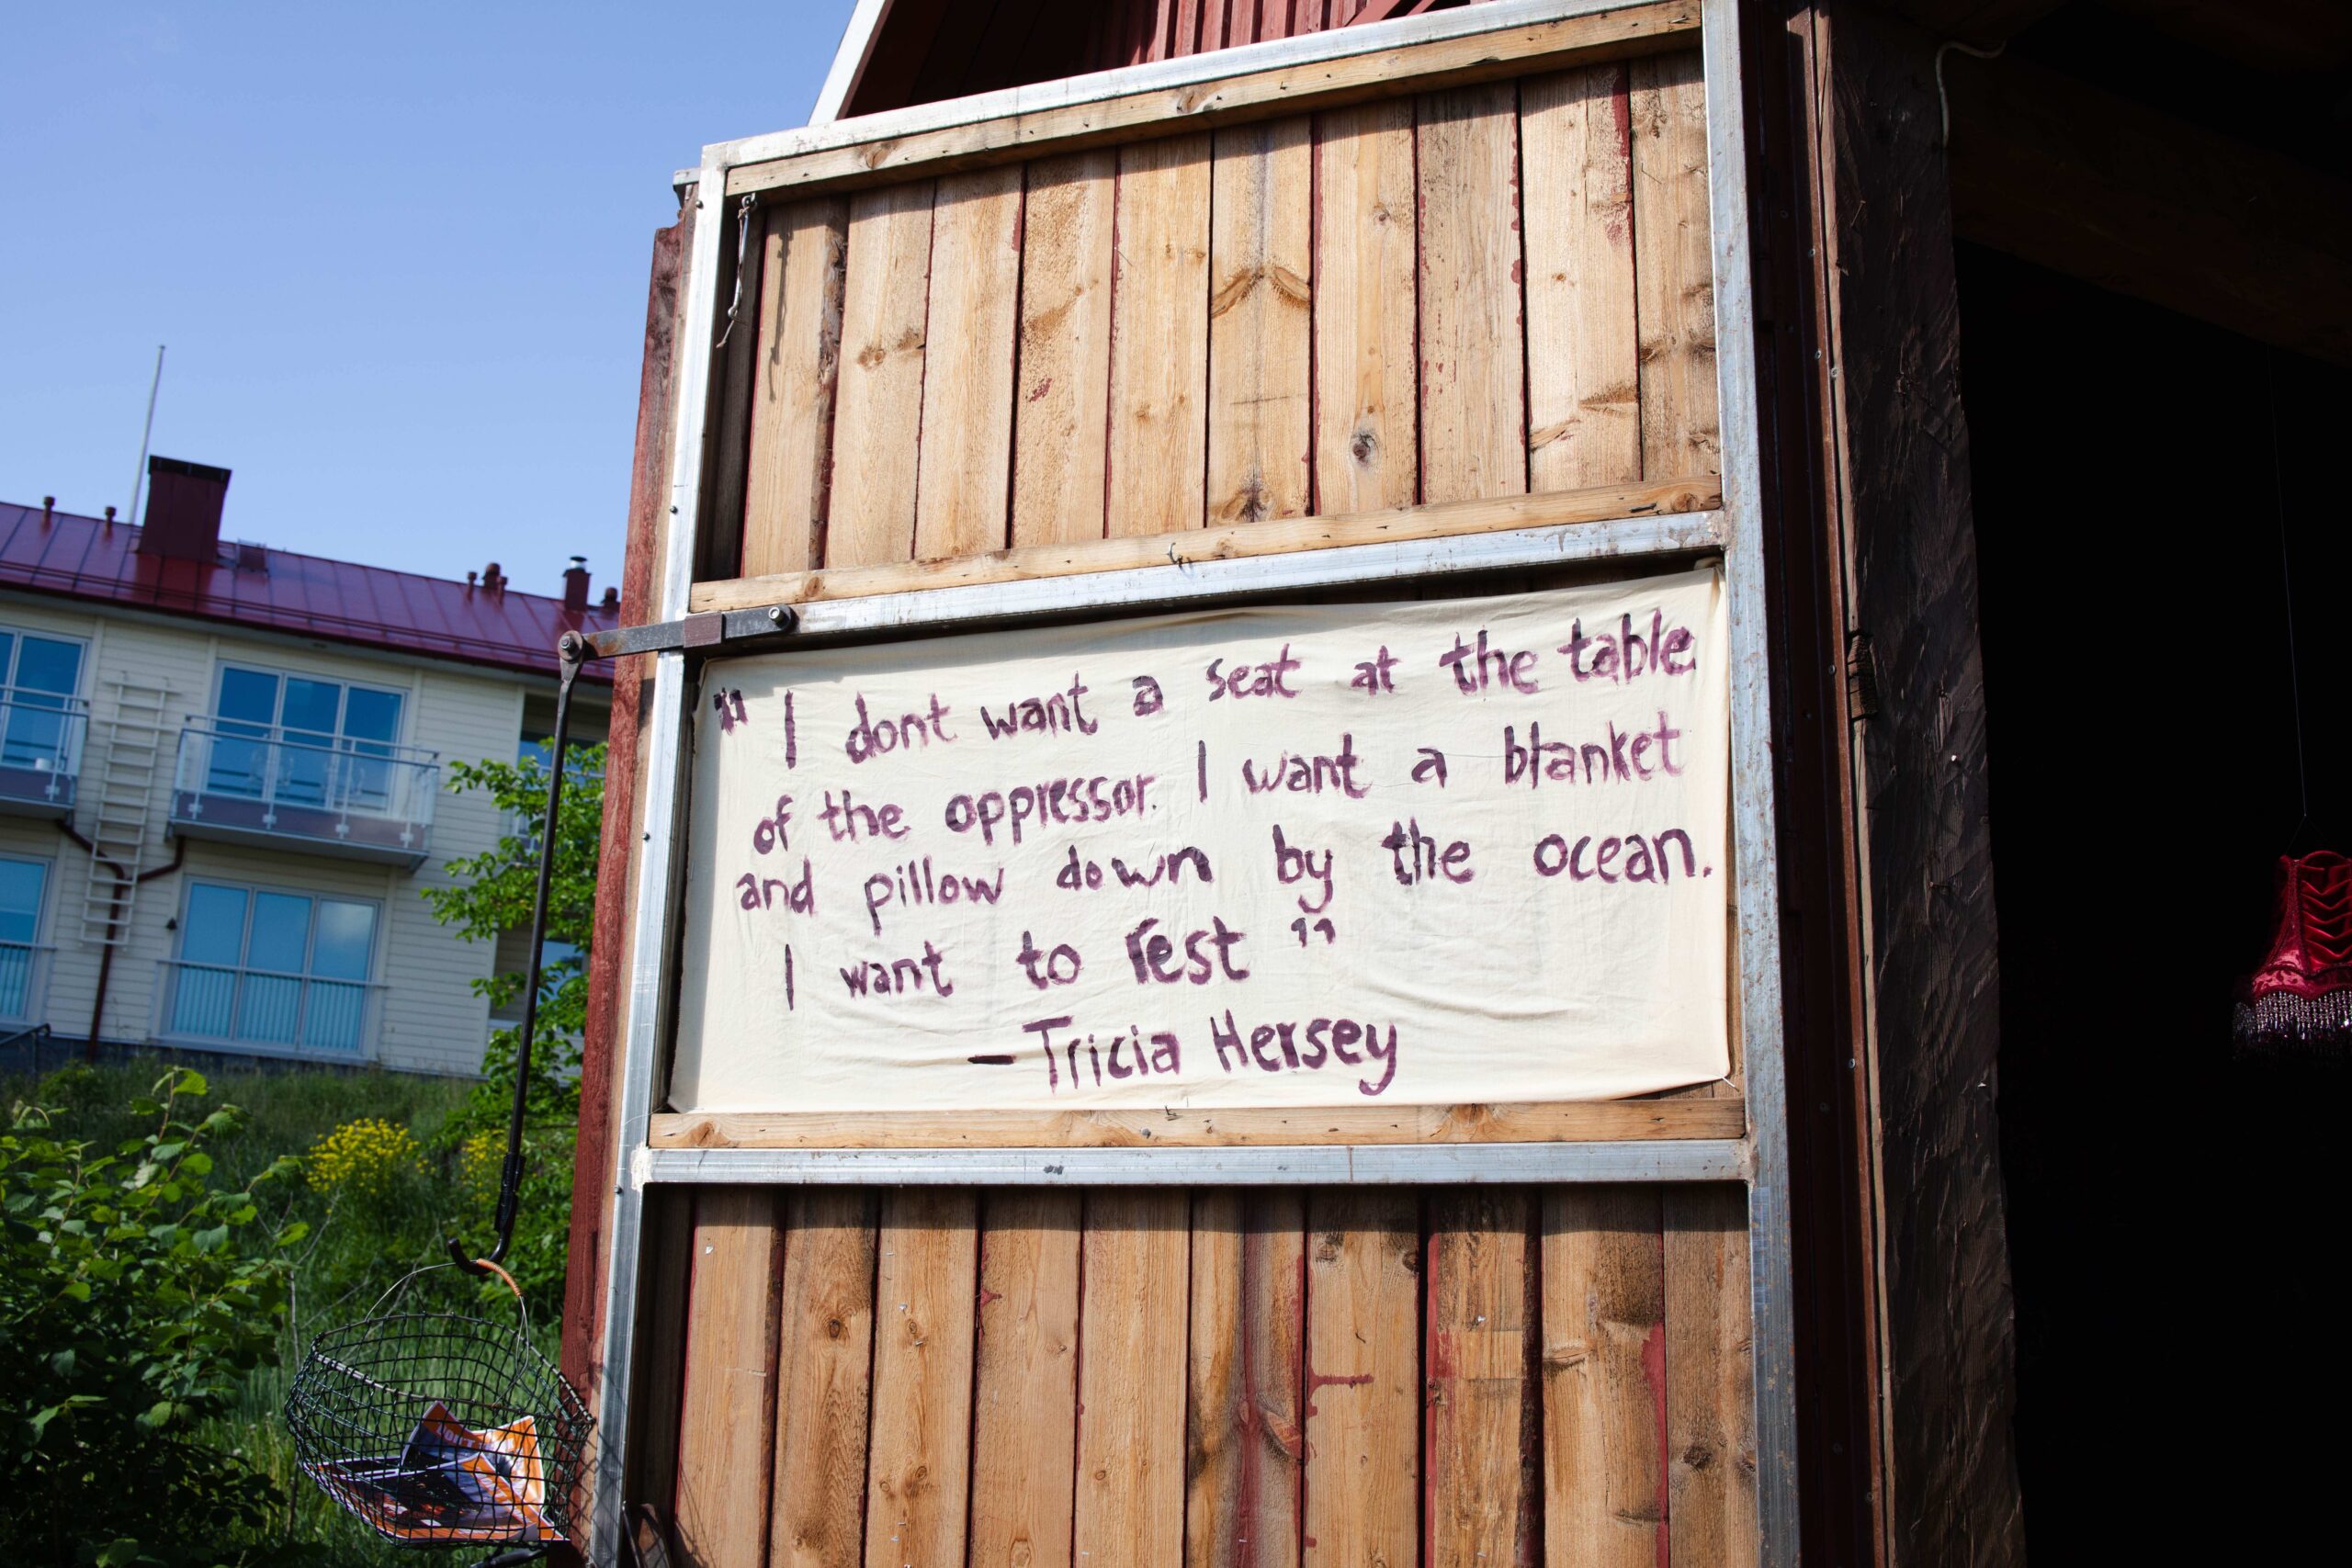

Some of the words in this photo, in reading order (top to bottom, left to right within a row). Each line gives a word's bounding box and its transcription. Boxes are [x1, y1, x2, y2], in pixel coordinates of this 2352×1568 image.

[845, 691, 956, 764] dont
[980, 671, 1098, 740] want
[1131, 675, 1164, 717] a
[1206, 643, 1302, 701] seat
[1351, 646, 1402, 697] at
[1438, 628, 1539, 696] the
[1556, 607, 1697, 684] table
[753, 795, 793, 854] of
[816, 790, 911, 843] the
[1197, 739, 1208, 803] I
[1242, 732, 1371, 799] want
[1411, 748, 1448, 788] a
[1504, 710, 1684, 790] blanket
[736, 855, 815, 917] and
[864, 854, 1004, 937] pillow
[1057, 845, 1214, 892] down
[1272, 824, 1333, 914] by
[1381, 817, 1475, 886] the
[1532, 828, 1713, 886] ocean.
[785, 943, 795, 1010] I
[840, 941, 954, 998] want
[1015, 931, 1082, 990] to
[1125, 916, 1250, 986] rest
[1210, 1009, 1397, 1096] Hersey
